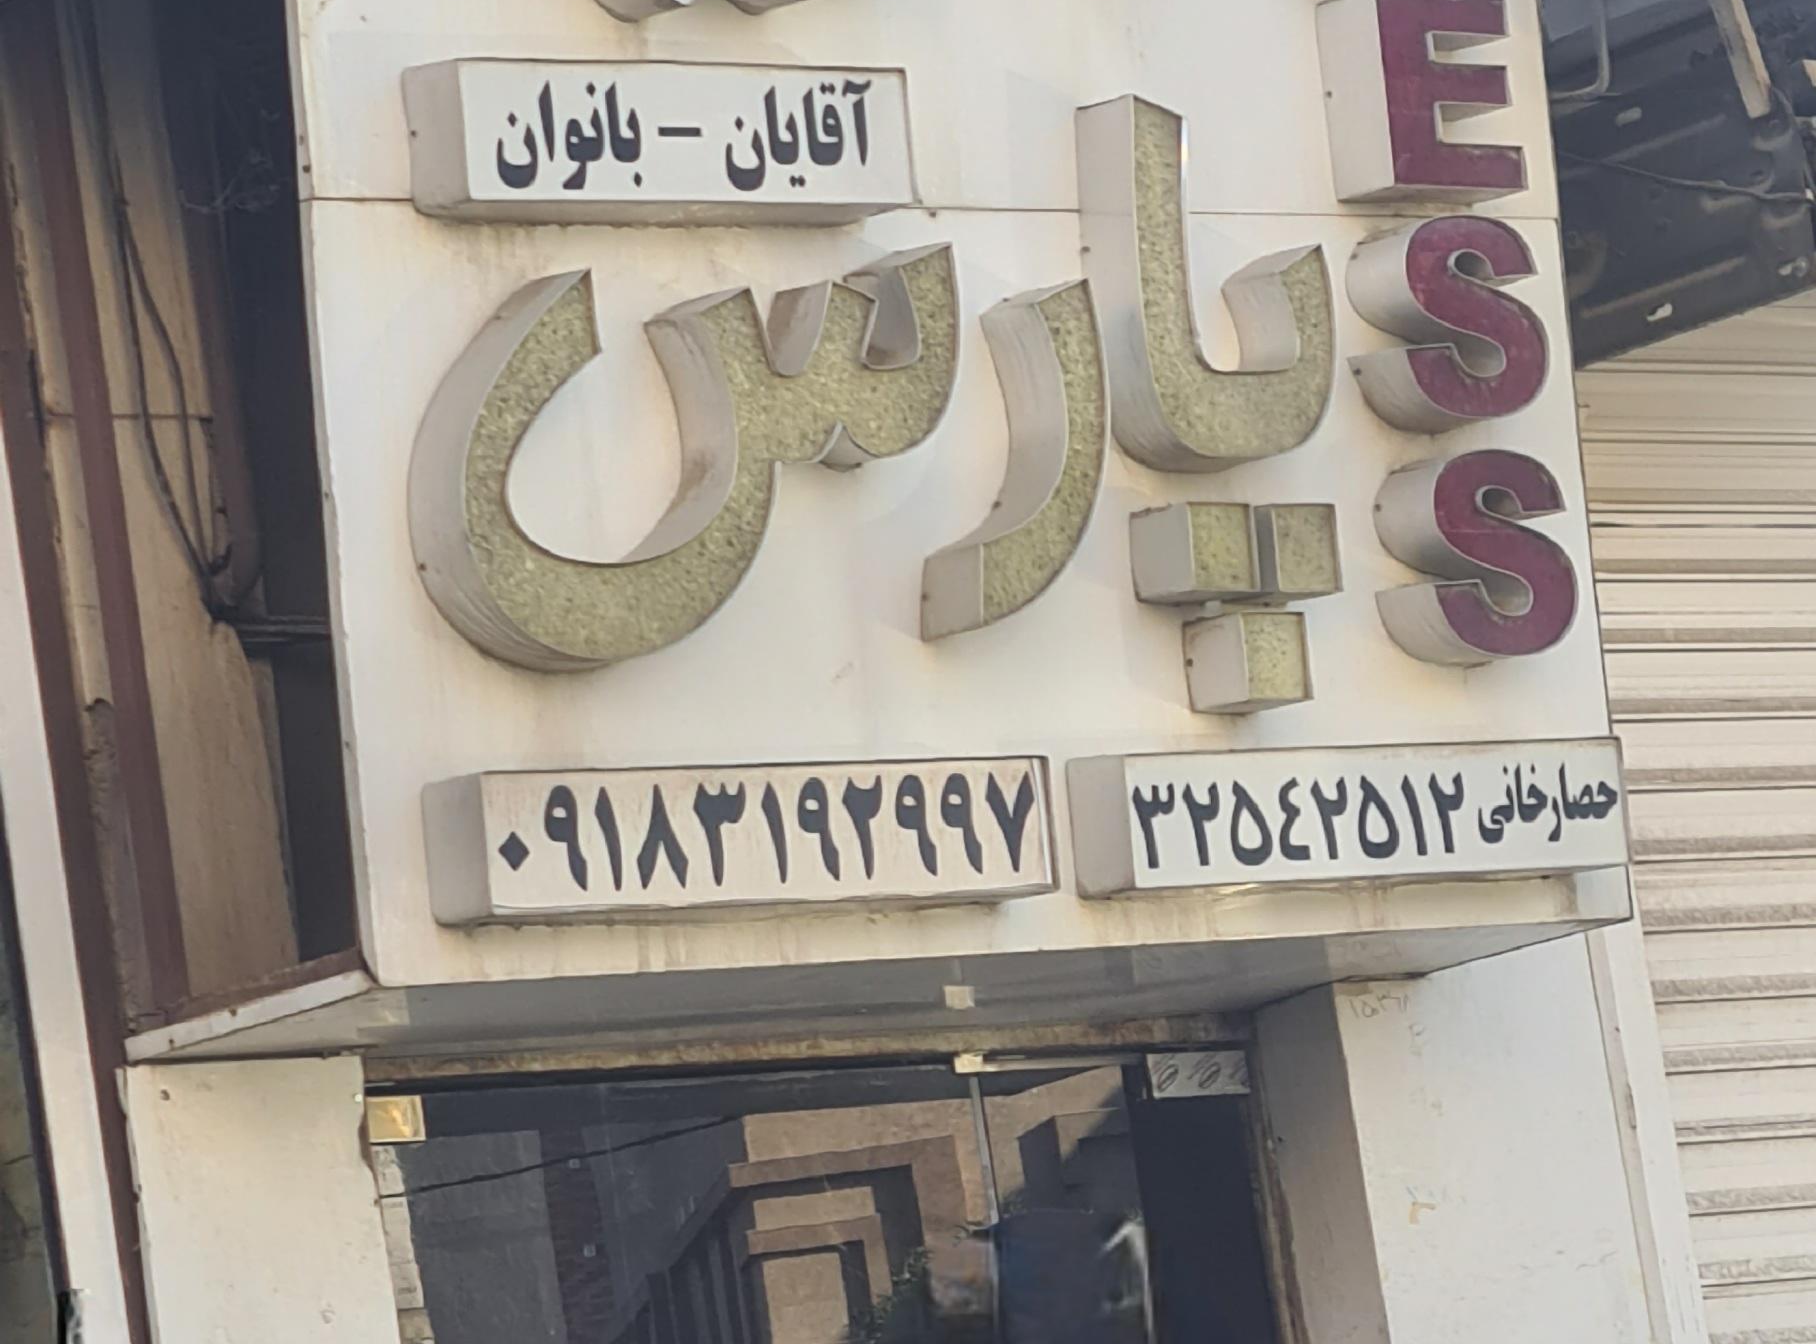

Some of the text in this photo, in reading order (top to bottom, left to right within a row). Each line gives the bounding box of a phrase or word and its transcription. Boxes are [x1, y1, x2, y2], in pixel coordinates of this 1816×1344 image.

[496, 81, 643, 191] بانوان
[725, 78, 873, 192] آقایان
[462, 93, 1343, 713] پارس
[498, 770, 1035, 892] ۰۹۱۸۳۱۹۲۹۹۷
